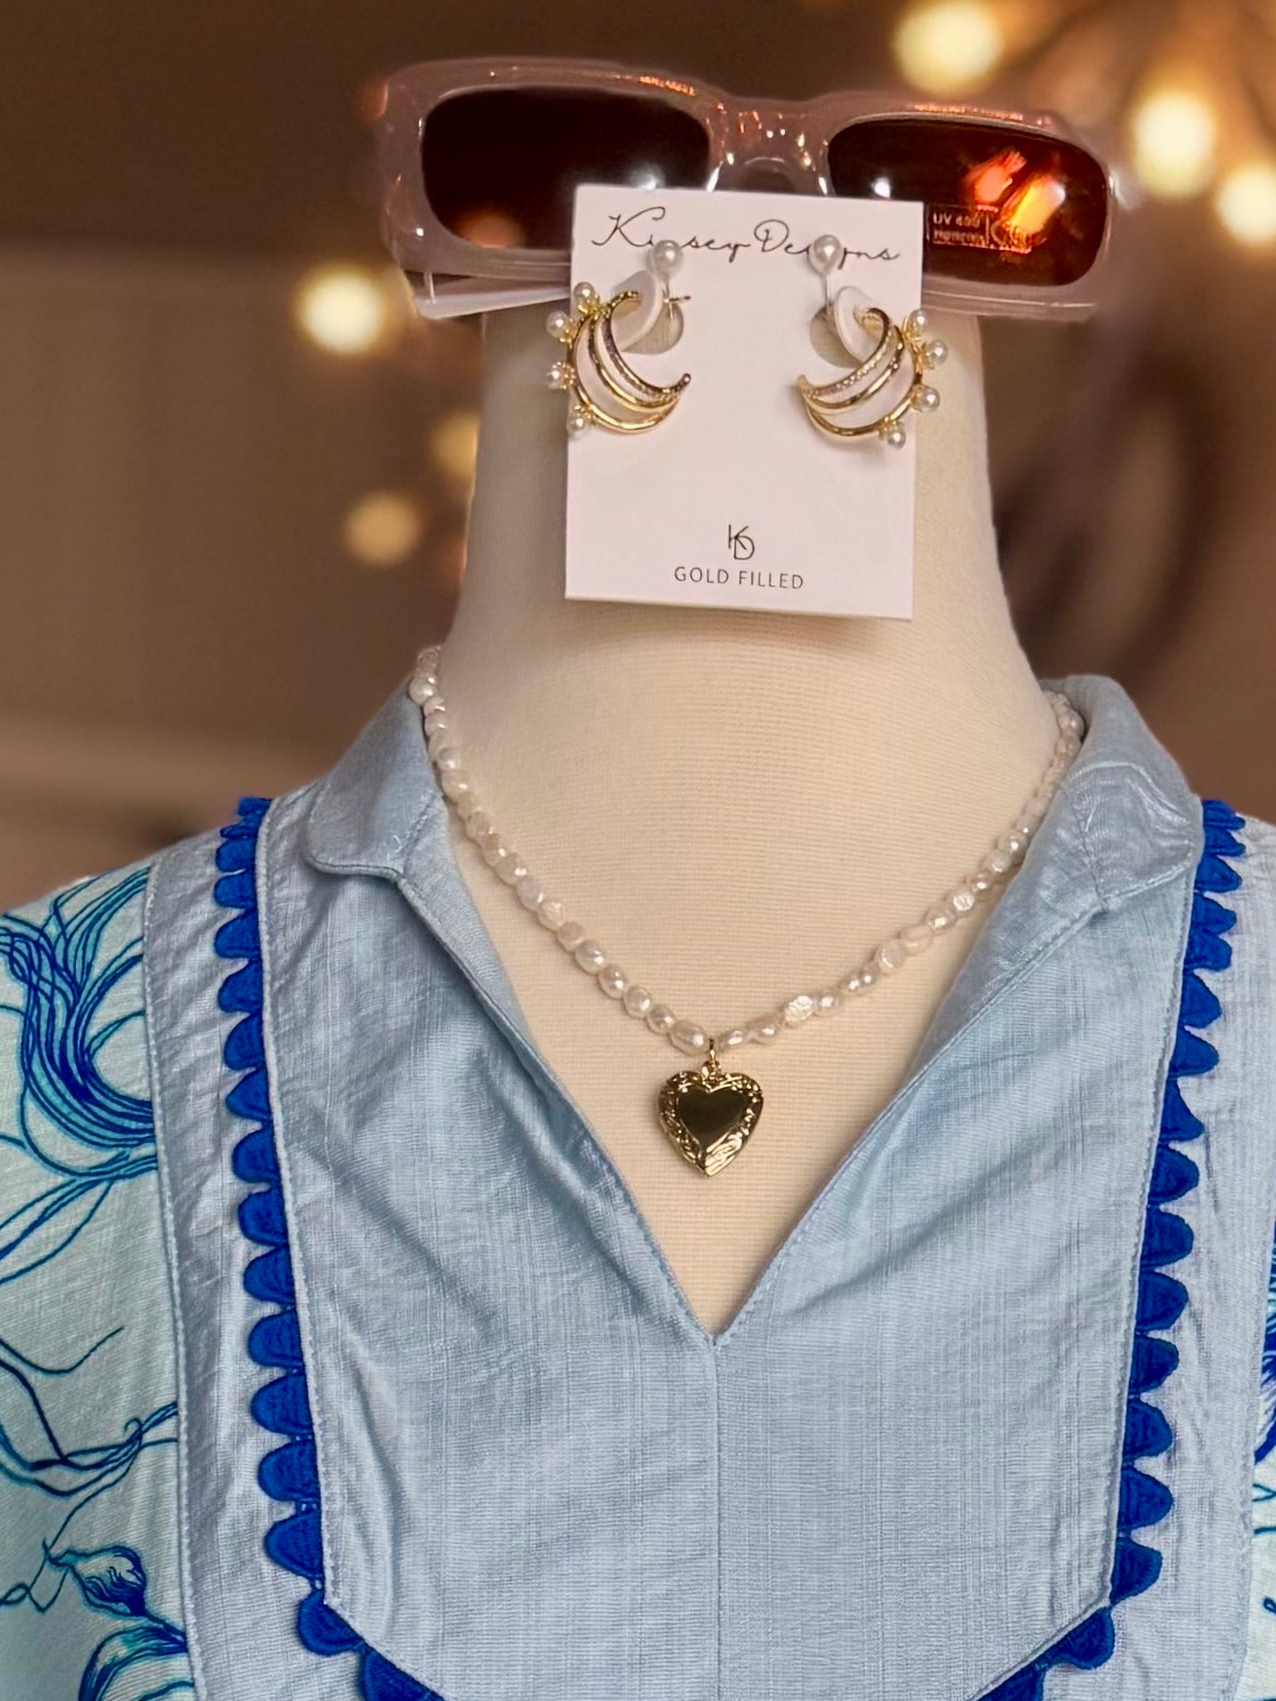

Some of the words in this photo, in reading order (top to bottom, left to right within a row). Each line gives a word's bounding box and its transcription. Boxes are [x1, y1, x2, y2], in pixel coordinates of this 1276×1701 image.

[932, 212, 953, 225] UV
[591, 206, 751, 264] Kisey
[753, 218, 901, 271] Degns
[674, 566, 730, 584] GOLD
[738, 569, 804, 590] FILLED
